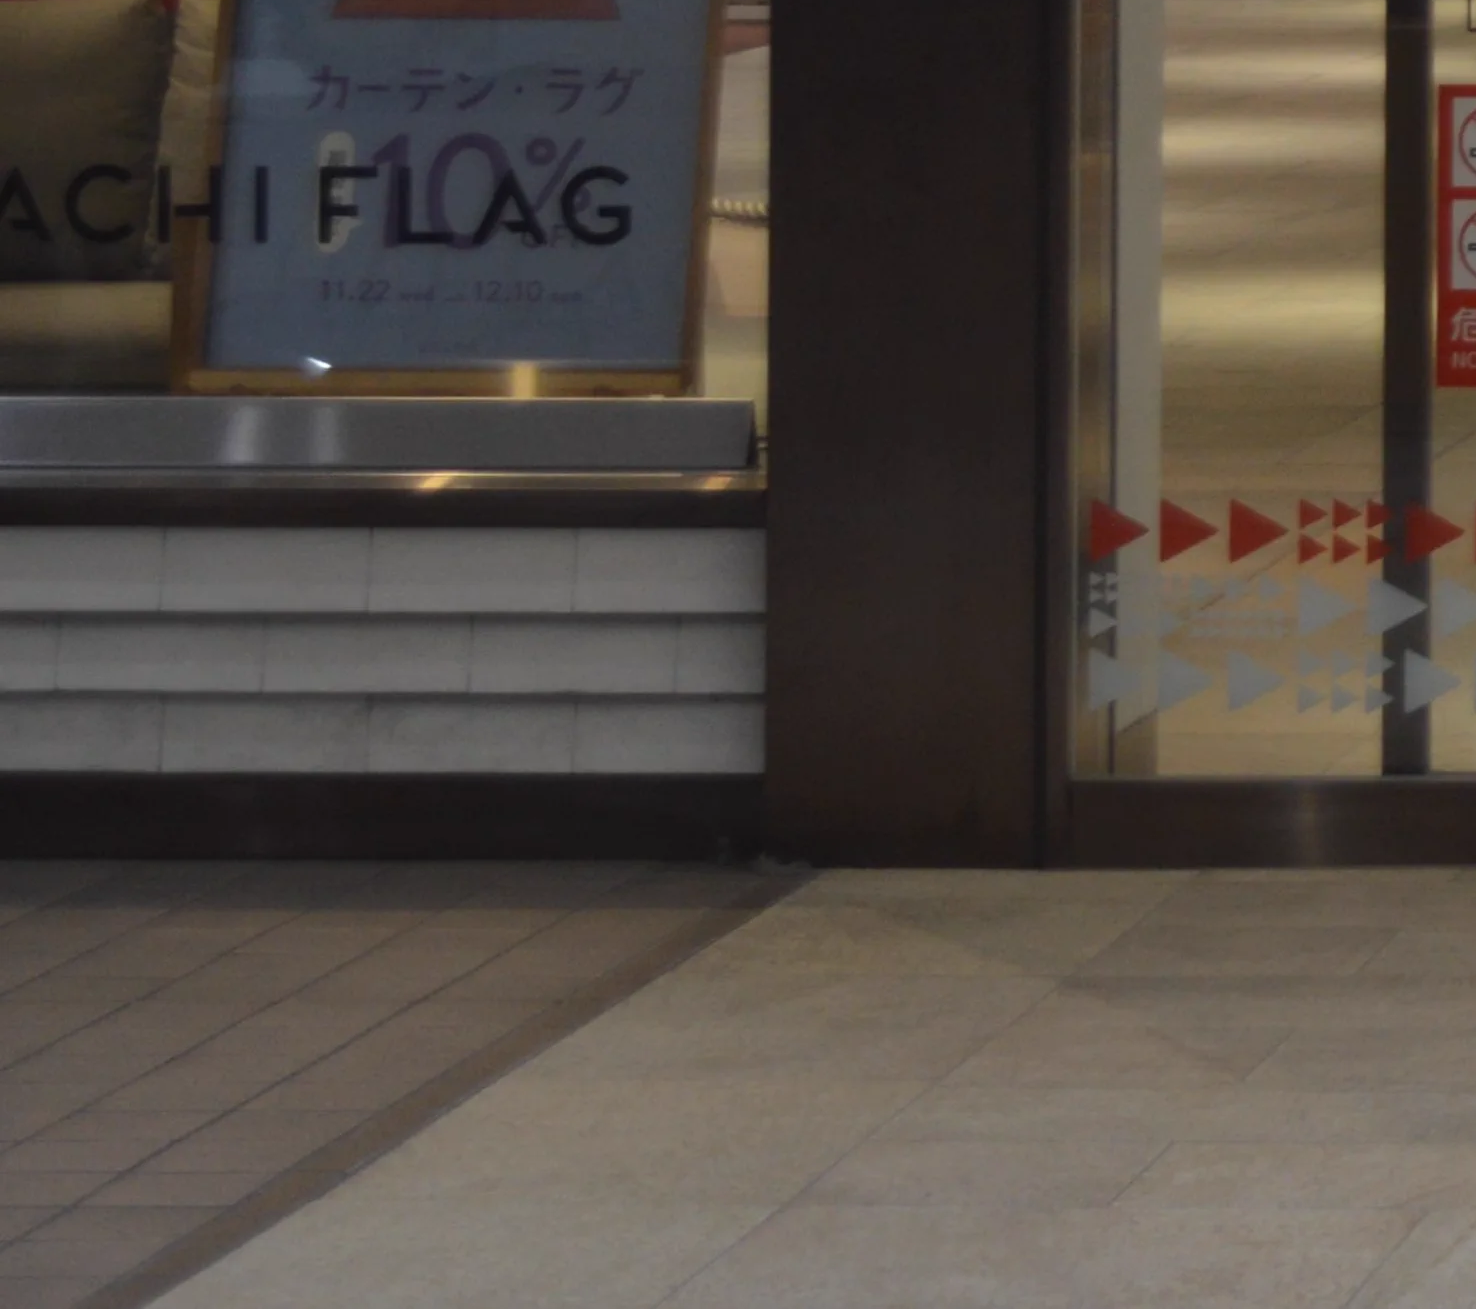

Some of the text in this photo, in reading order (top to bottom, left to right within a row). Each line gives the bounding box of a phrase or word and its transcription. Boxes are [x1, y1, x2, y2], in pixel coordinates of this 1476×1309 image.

[305, 64, 645, 115] カーテン・ラグ
[318, 166, 633, 246] FLAG
